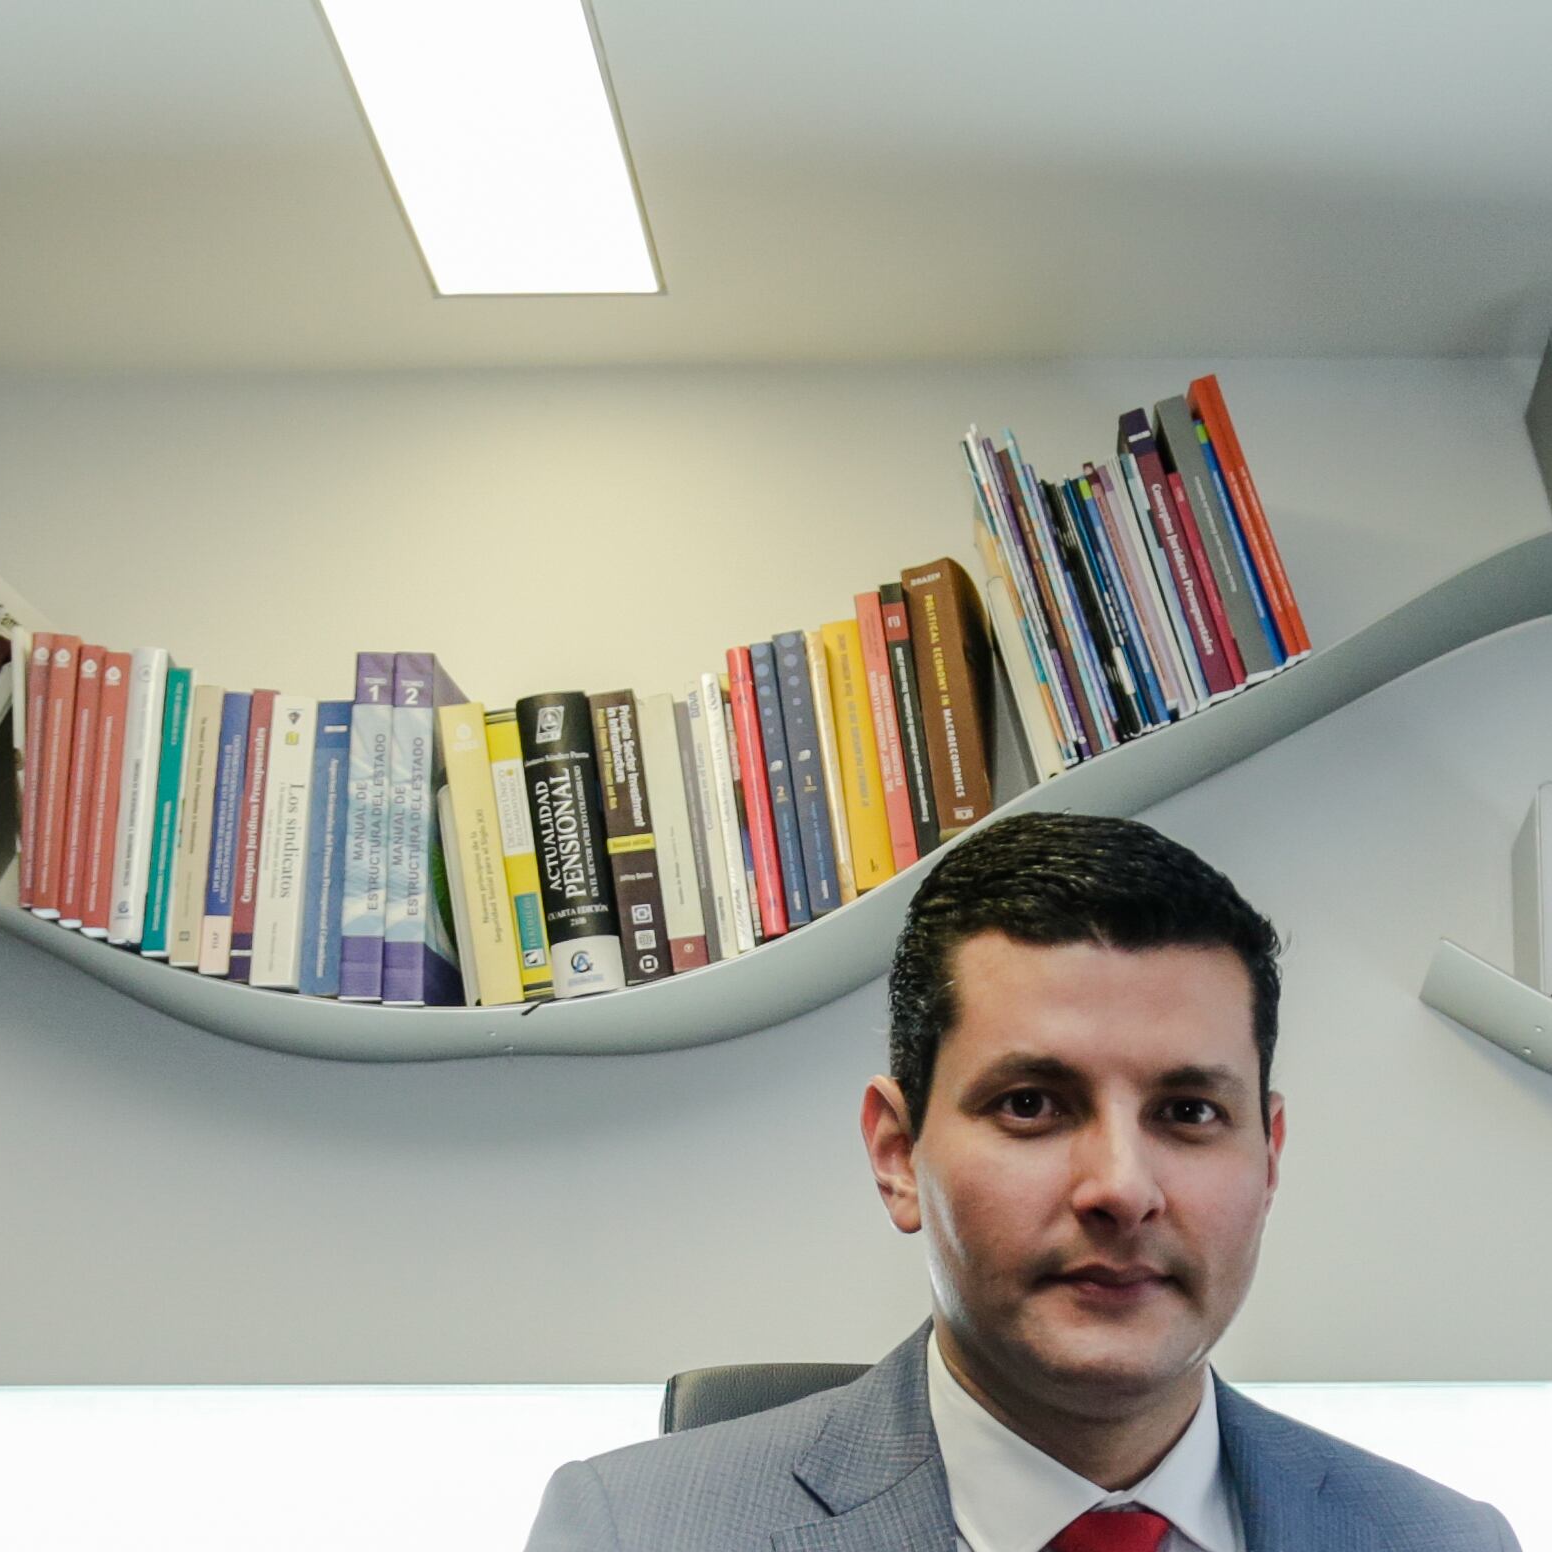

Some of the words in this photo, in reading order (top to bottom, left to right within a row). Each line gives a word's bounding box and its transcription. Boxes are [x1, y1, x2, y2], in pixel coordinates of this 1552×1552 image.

[1149, 481, 1175, 534] Conceptos
[923, 593, 941, 643] POLITICAL
[368, 685, 380, 702] 1
[932, 646, 948, 691] ECONOMY
[405, 688, 419, 705] 2
[606, 706, 616, 717] in
[616, 703, 633, 739] Private
[940, 693, 951, 706] IN
[372, 733, 386, 786] ESTADO
[411, 737, 425, 790] ESTADO
[607, 718, 625, 783] Infrastructure
[622, 739, 637, 771] Sector
[942, 707, 965, 798] MACROECONOMICS
[287, 782, 304, 813] Los
[356, 782, 367, 800] DE
[371, 790, 384, 816] DEL
[394, 786, 405, 804] DE
[410, 795, 422, 819] DEL
[627, 772, 645, 828] Investment
[279, 817, 300, 898] sindicatos
[353, 804, 366, 860] MANUAL
[391, 809, 404, 865] MANUAL
[534, 780, 563, 892] ACTUALIDAD
[546, 767, 587, 899] PENSIONAL
[366, 818, 381, 910] ESTRUCTURA
[406, 823, 421, 916] ESTRUCTURA
